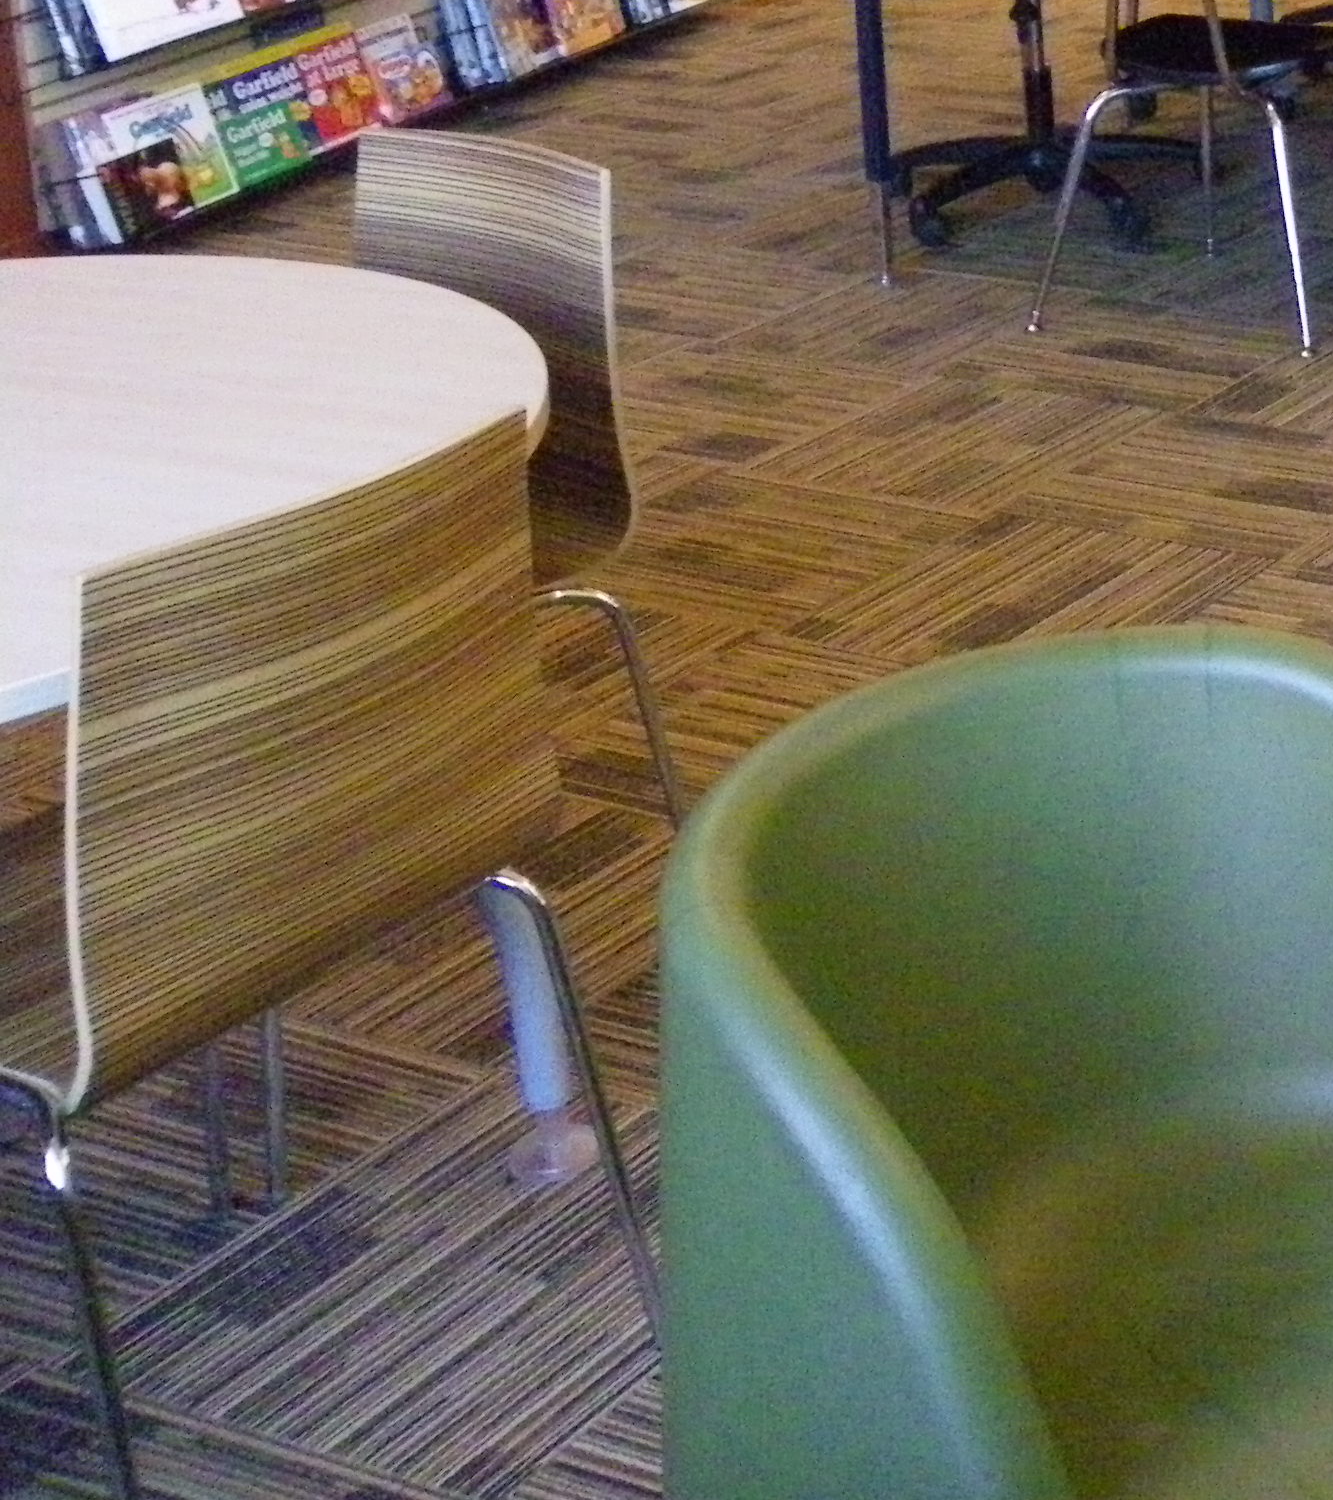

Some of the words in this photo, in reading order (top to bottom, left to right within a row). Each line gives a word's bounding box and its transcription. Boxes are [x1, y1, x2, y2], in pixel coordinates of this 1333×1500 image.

[297, 37, 357, 71] Garfield
[232, 60, 299, 100] Garfield
[225, 108, 288, 144] Garfield
